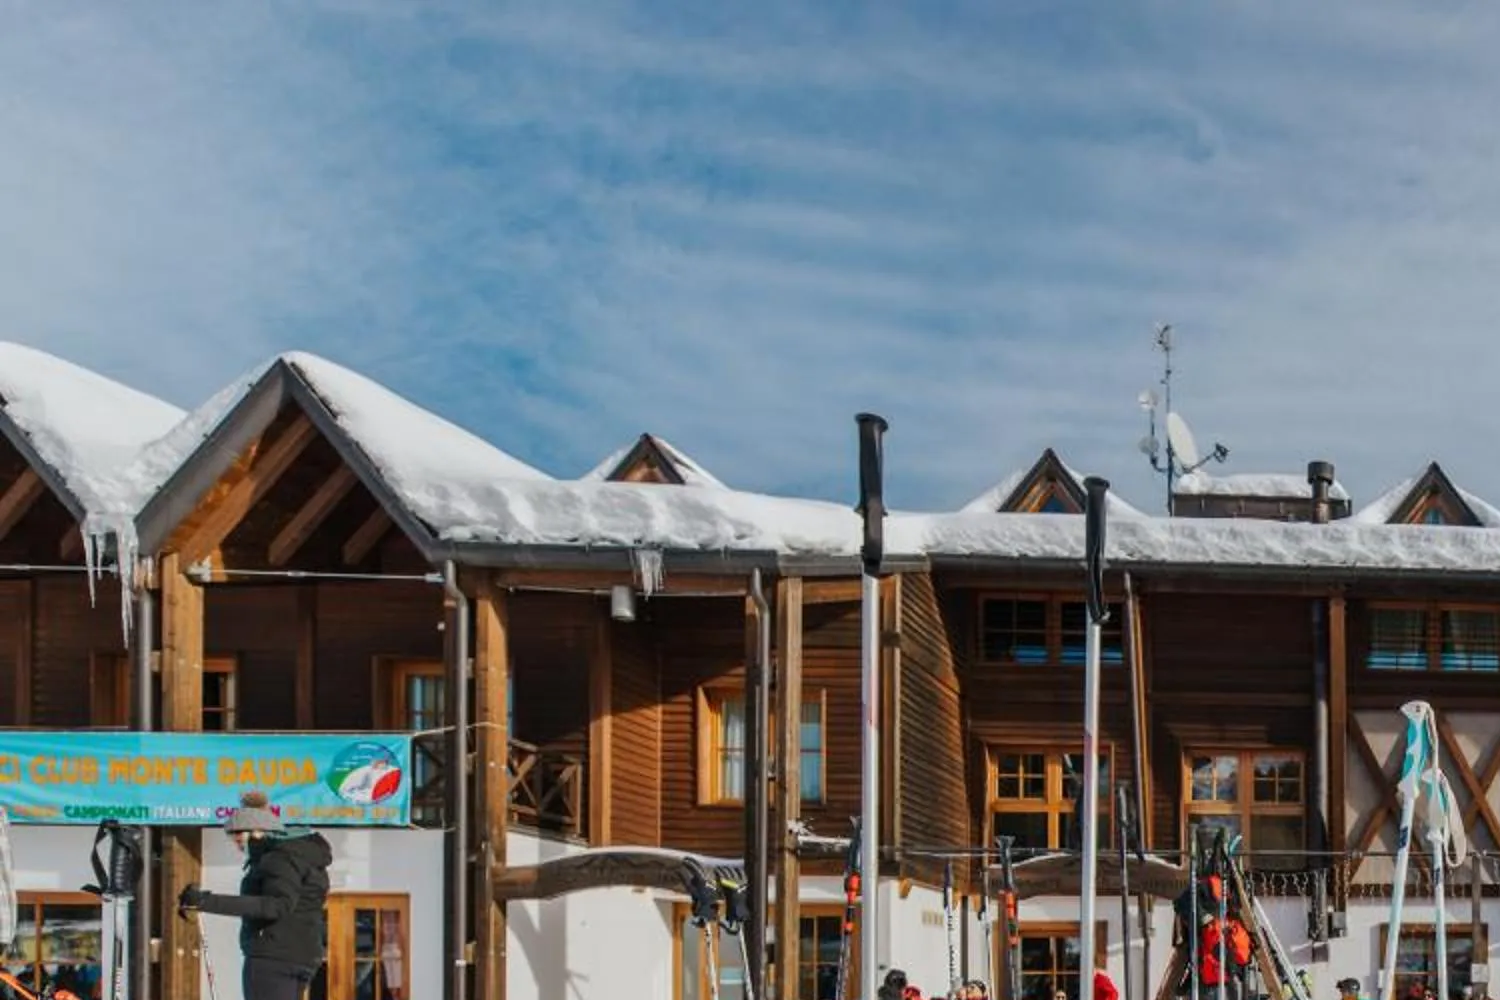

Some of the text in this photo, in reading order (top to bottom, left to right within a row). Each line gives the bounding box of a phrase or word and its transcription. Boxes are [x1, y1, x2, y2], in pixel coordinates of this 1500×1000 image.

[29, 754, 98, 785] CLUB
[108, 755, 209, 786] MONTE
[217, 756, 318, 787] DAUDA
[63, 804, 149, 818] CAMPIONATI
[153, 805, 211, 818] ITALIANI
